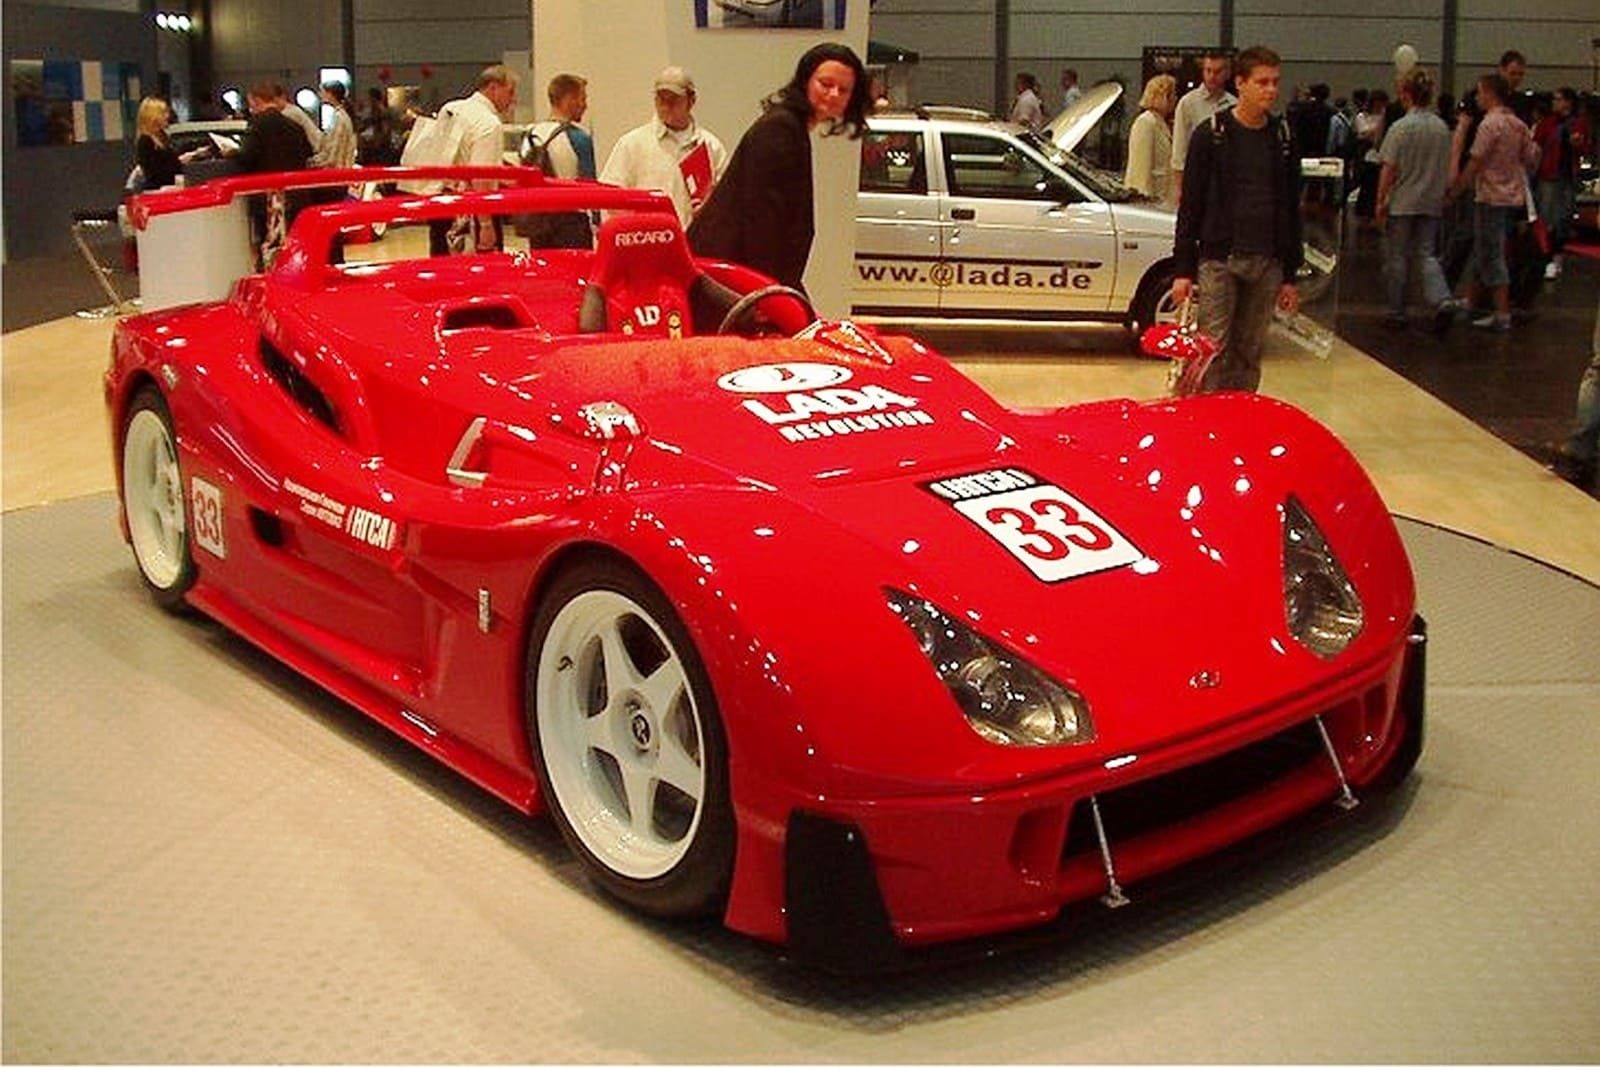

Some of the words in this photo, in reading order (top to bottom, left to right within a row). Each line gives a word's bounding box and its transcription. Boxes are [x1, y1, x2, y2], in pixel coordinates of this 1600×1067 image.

[615, 229, 675, 247] RECARO
[742, 384, 919, 425] LADA
[778, 410, 936, 443] REVOLUTION
[194, 490, 221, 546] 33
[985, 498, 1114, 561] 33
